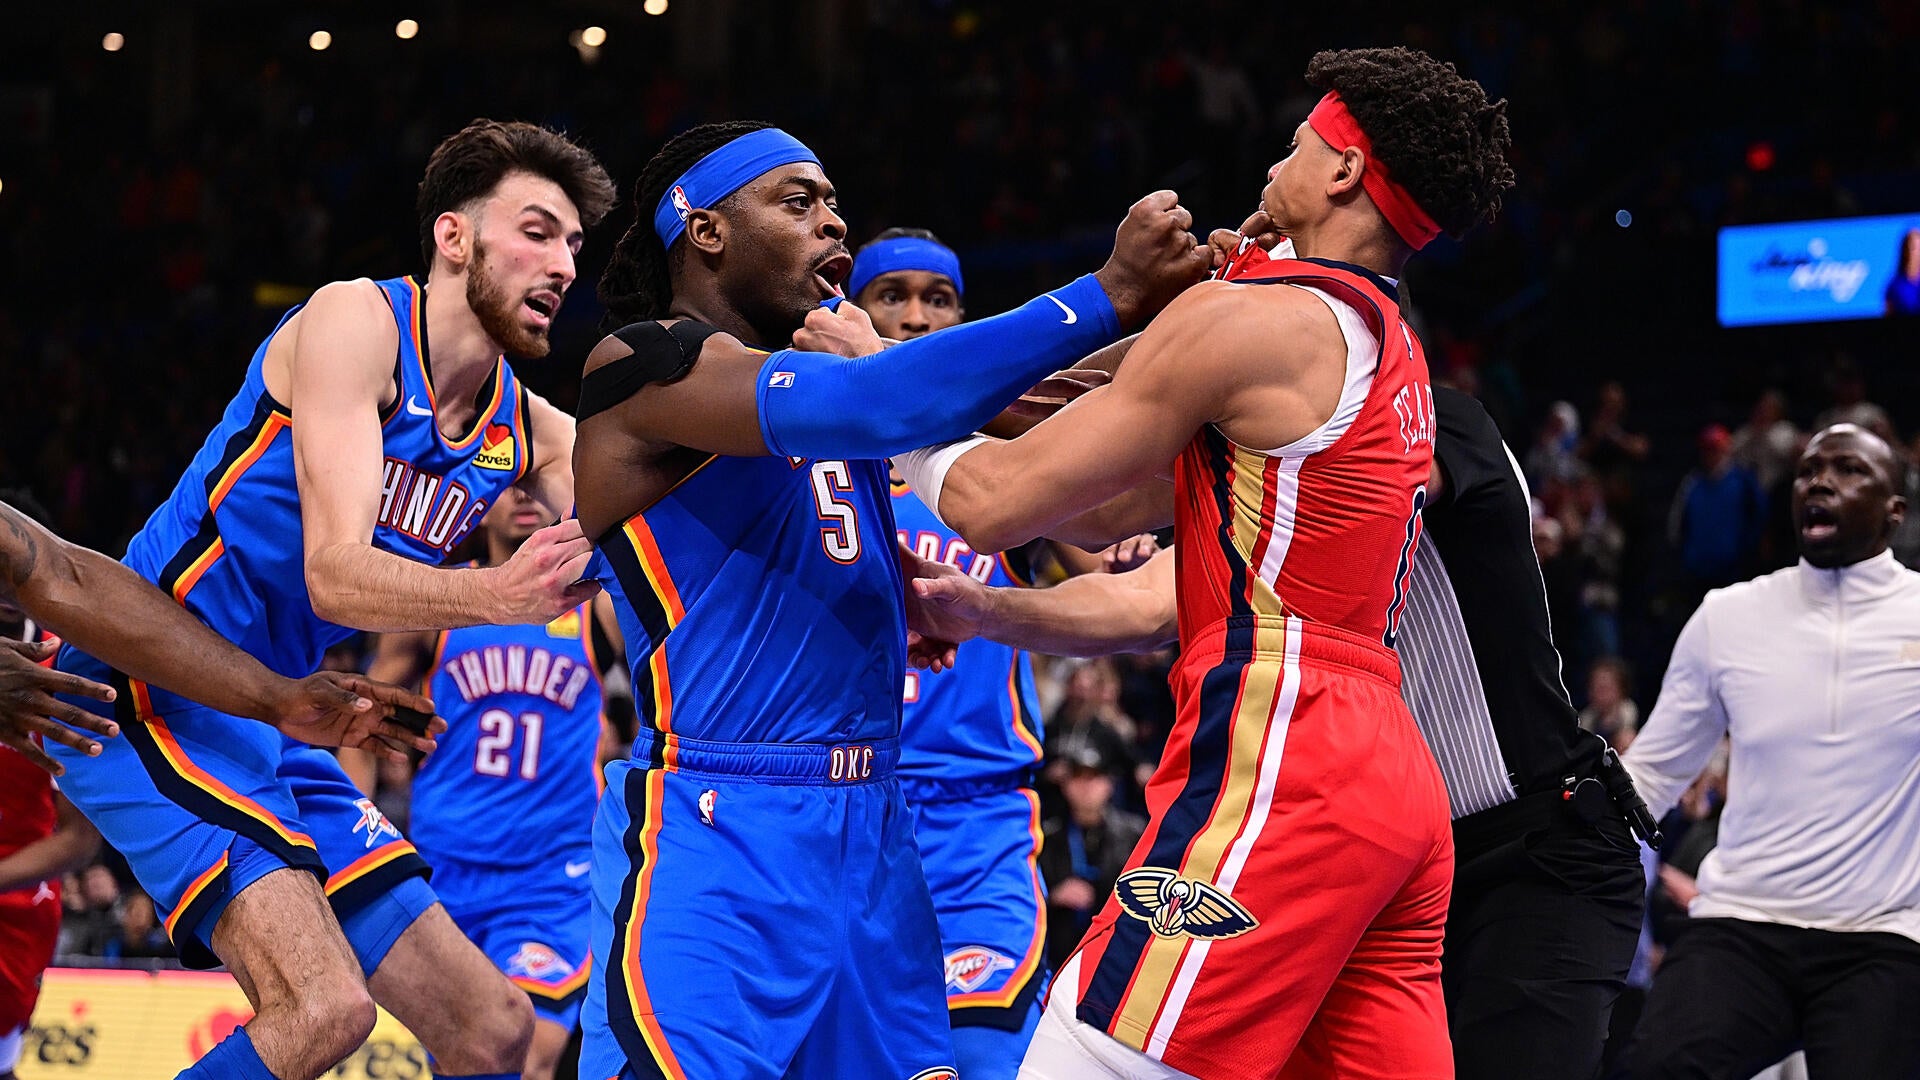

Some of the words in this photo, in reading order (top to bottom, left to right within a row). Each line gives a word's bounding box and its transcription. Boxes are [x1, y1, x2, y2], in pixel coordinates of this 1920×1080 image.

[809, 459, 862, 566] 5
[445, 645, 591, 712] THUNDER
[474, 708, 544, 781] 21
[829, 745, 874, 782] OKC
